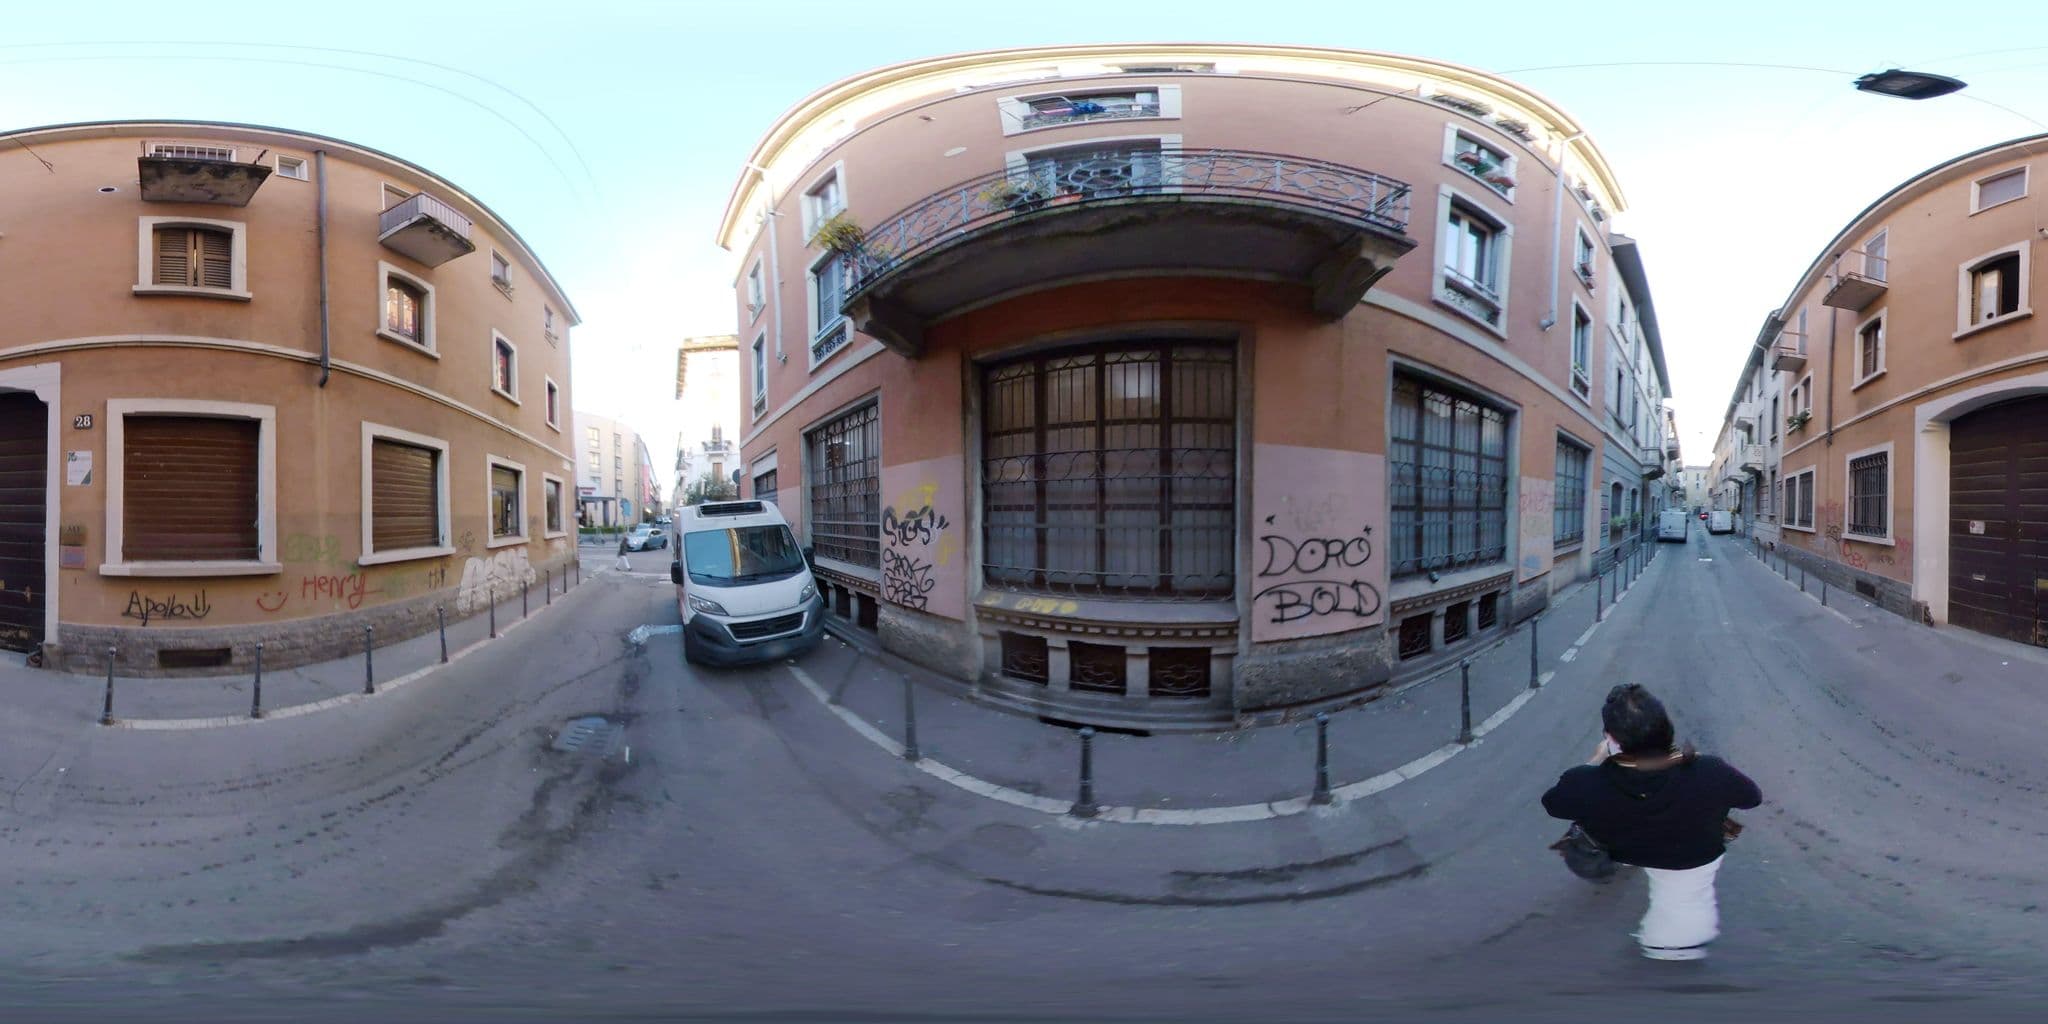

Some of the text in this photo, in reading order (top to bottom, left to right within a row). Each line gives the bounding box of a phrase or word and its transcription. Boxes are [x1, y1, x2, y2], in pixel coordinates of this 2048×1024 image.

[75, 415, 91, 428] 28
[1258, 535, 1371, 577] DORO
[122, 590, 188, 627] Apollo
[302, 572, 380, 610] Henry
[1258, 580, 1380, 622] BOLD
